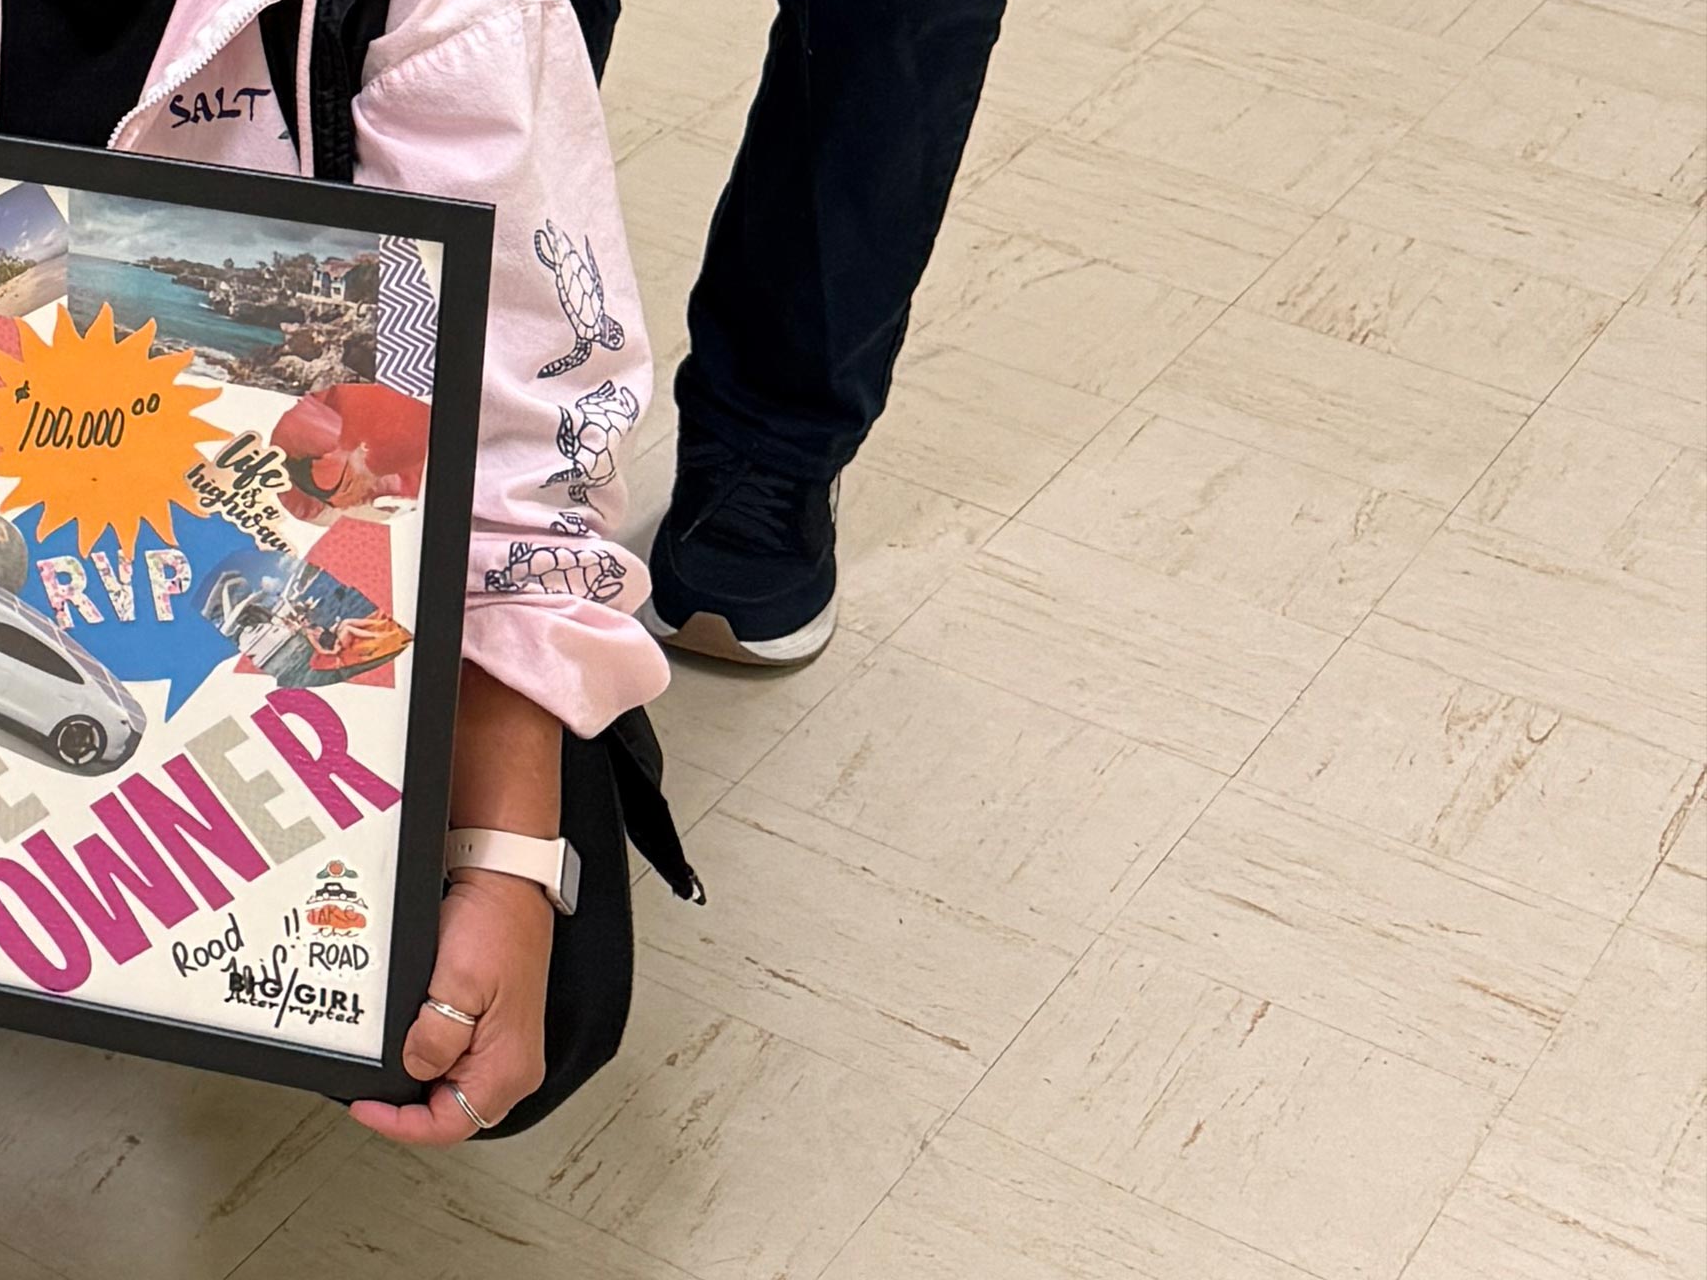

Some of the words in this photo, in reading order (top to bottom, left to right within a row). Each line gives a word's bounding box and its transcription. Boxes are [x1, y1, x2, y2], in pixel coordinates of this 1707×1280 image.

[169, 87, 271, 129] SALT
[216, 434, 286, 489] life
[241, 488, 264, 509] is
[263, 505, 281, 520] a
[172, 913, 244, 977] Road
[309, 943, 369, 971] ROAD
